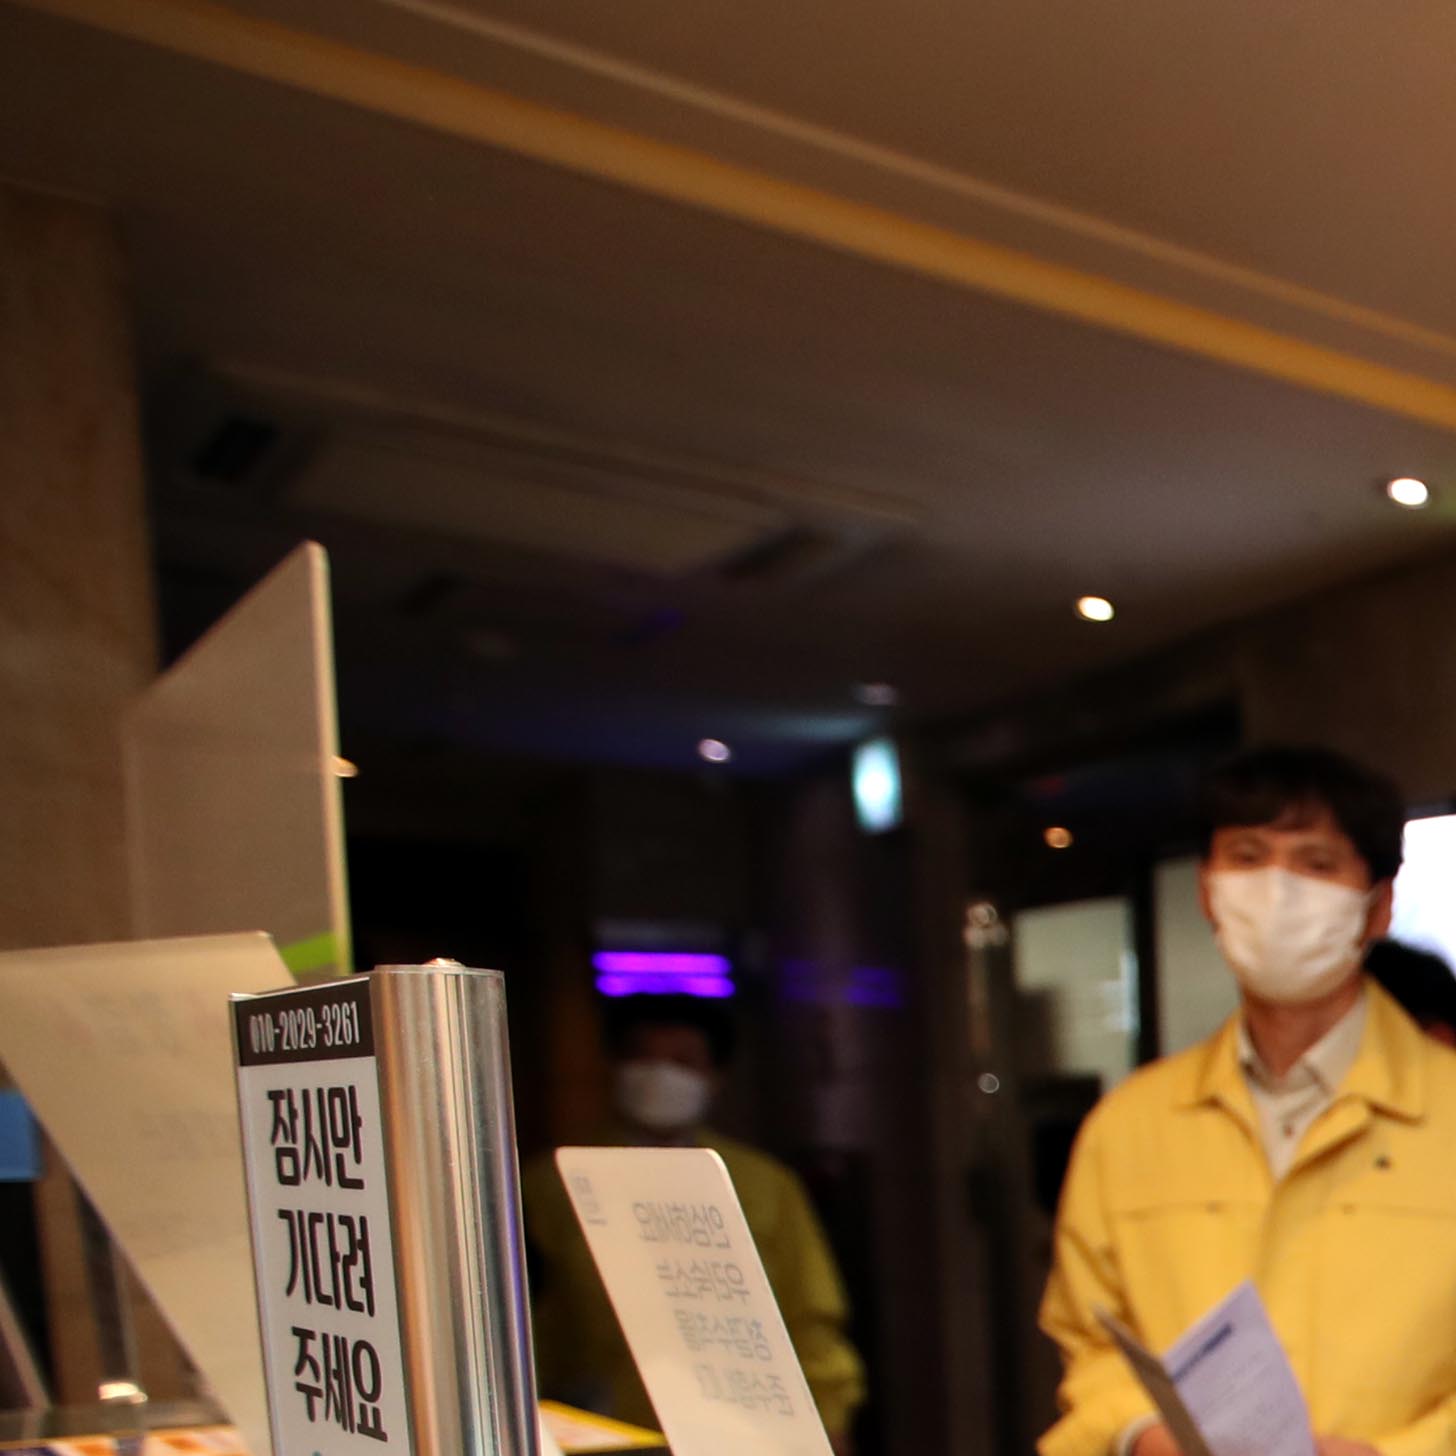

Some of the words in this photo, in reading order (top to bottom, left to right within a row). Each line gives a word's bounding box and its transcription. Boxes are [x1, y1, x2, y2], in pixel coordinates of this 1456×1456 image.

[249, 1001, 360, 1053] 010-2029-3261
[266, 1085, 364, 1190] 잠시만
[277, 1209, 375, 1317] 기다려
[291, 1327, 388, 1442] 주세요
